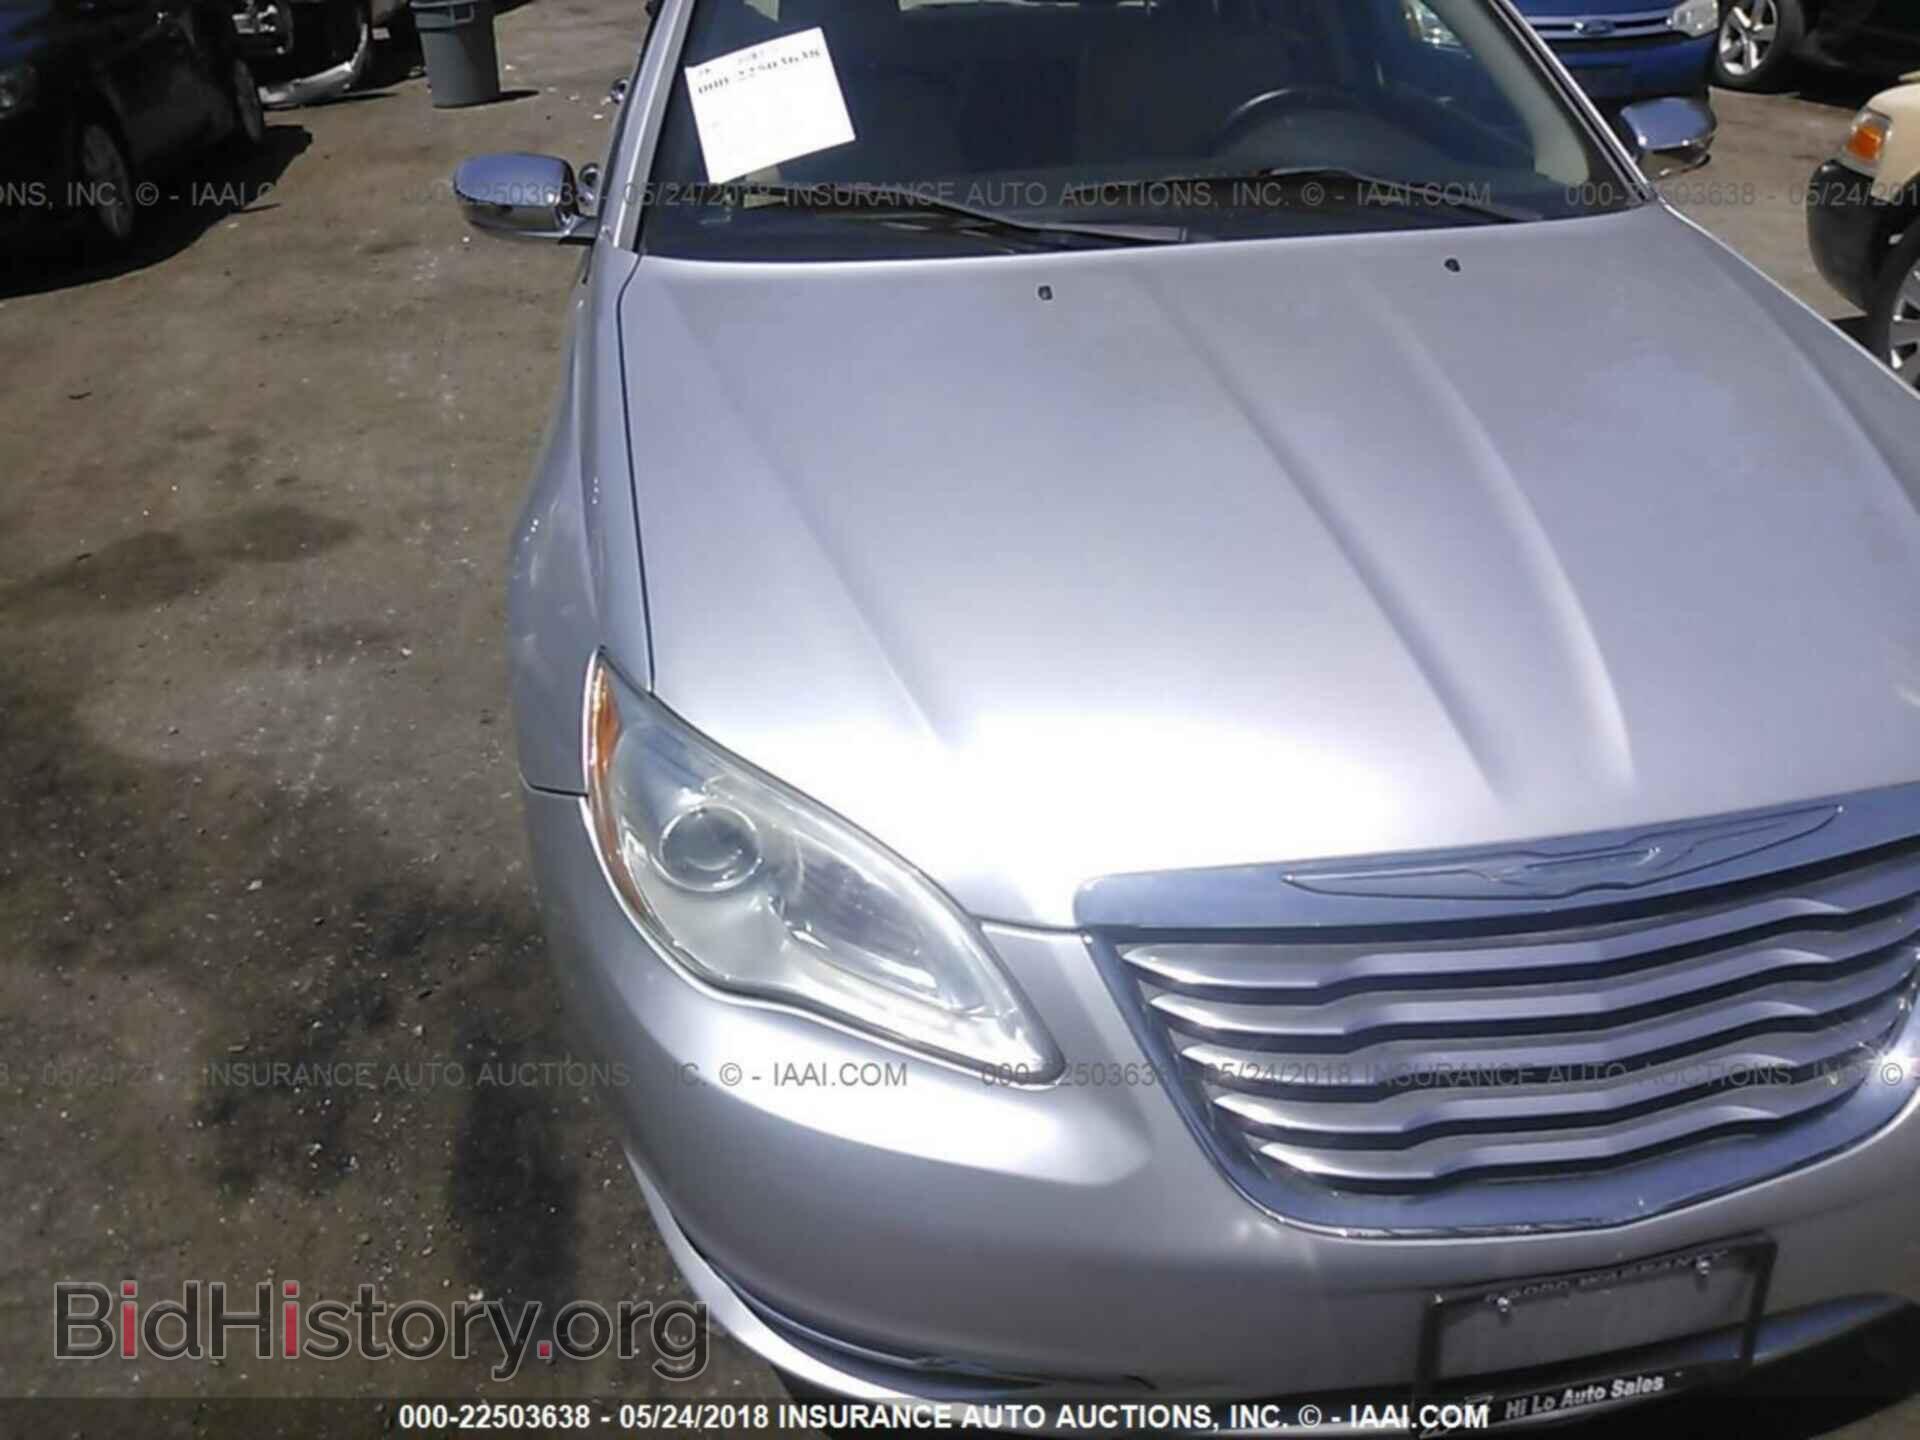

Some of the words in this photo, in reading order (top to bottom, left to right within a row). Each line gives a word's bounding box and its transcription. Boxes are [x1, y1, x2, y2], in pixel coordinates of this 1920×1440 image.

[1505, 1398, 1527, 1419] Hi
[1531, 1395, 1556, 1414] Lo
[1560, 1384, 1607, 1409] Auto
[1610, 1375, 1666, 1398] Sales
